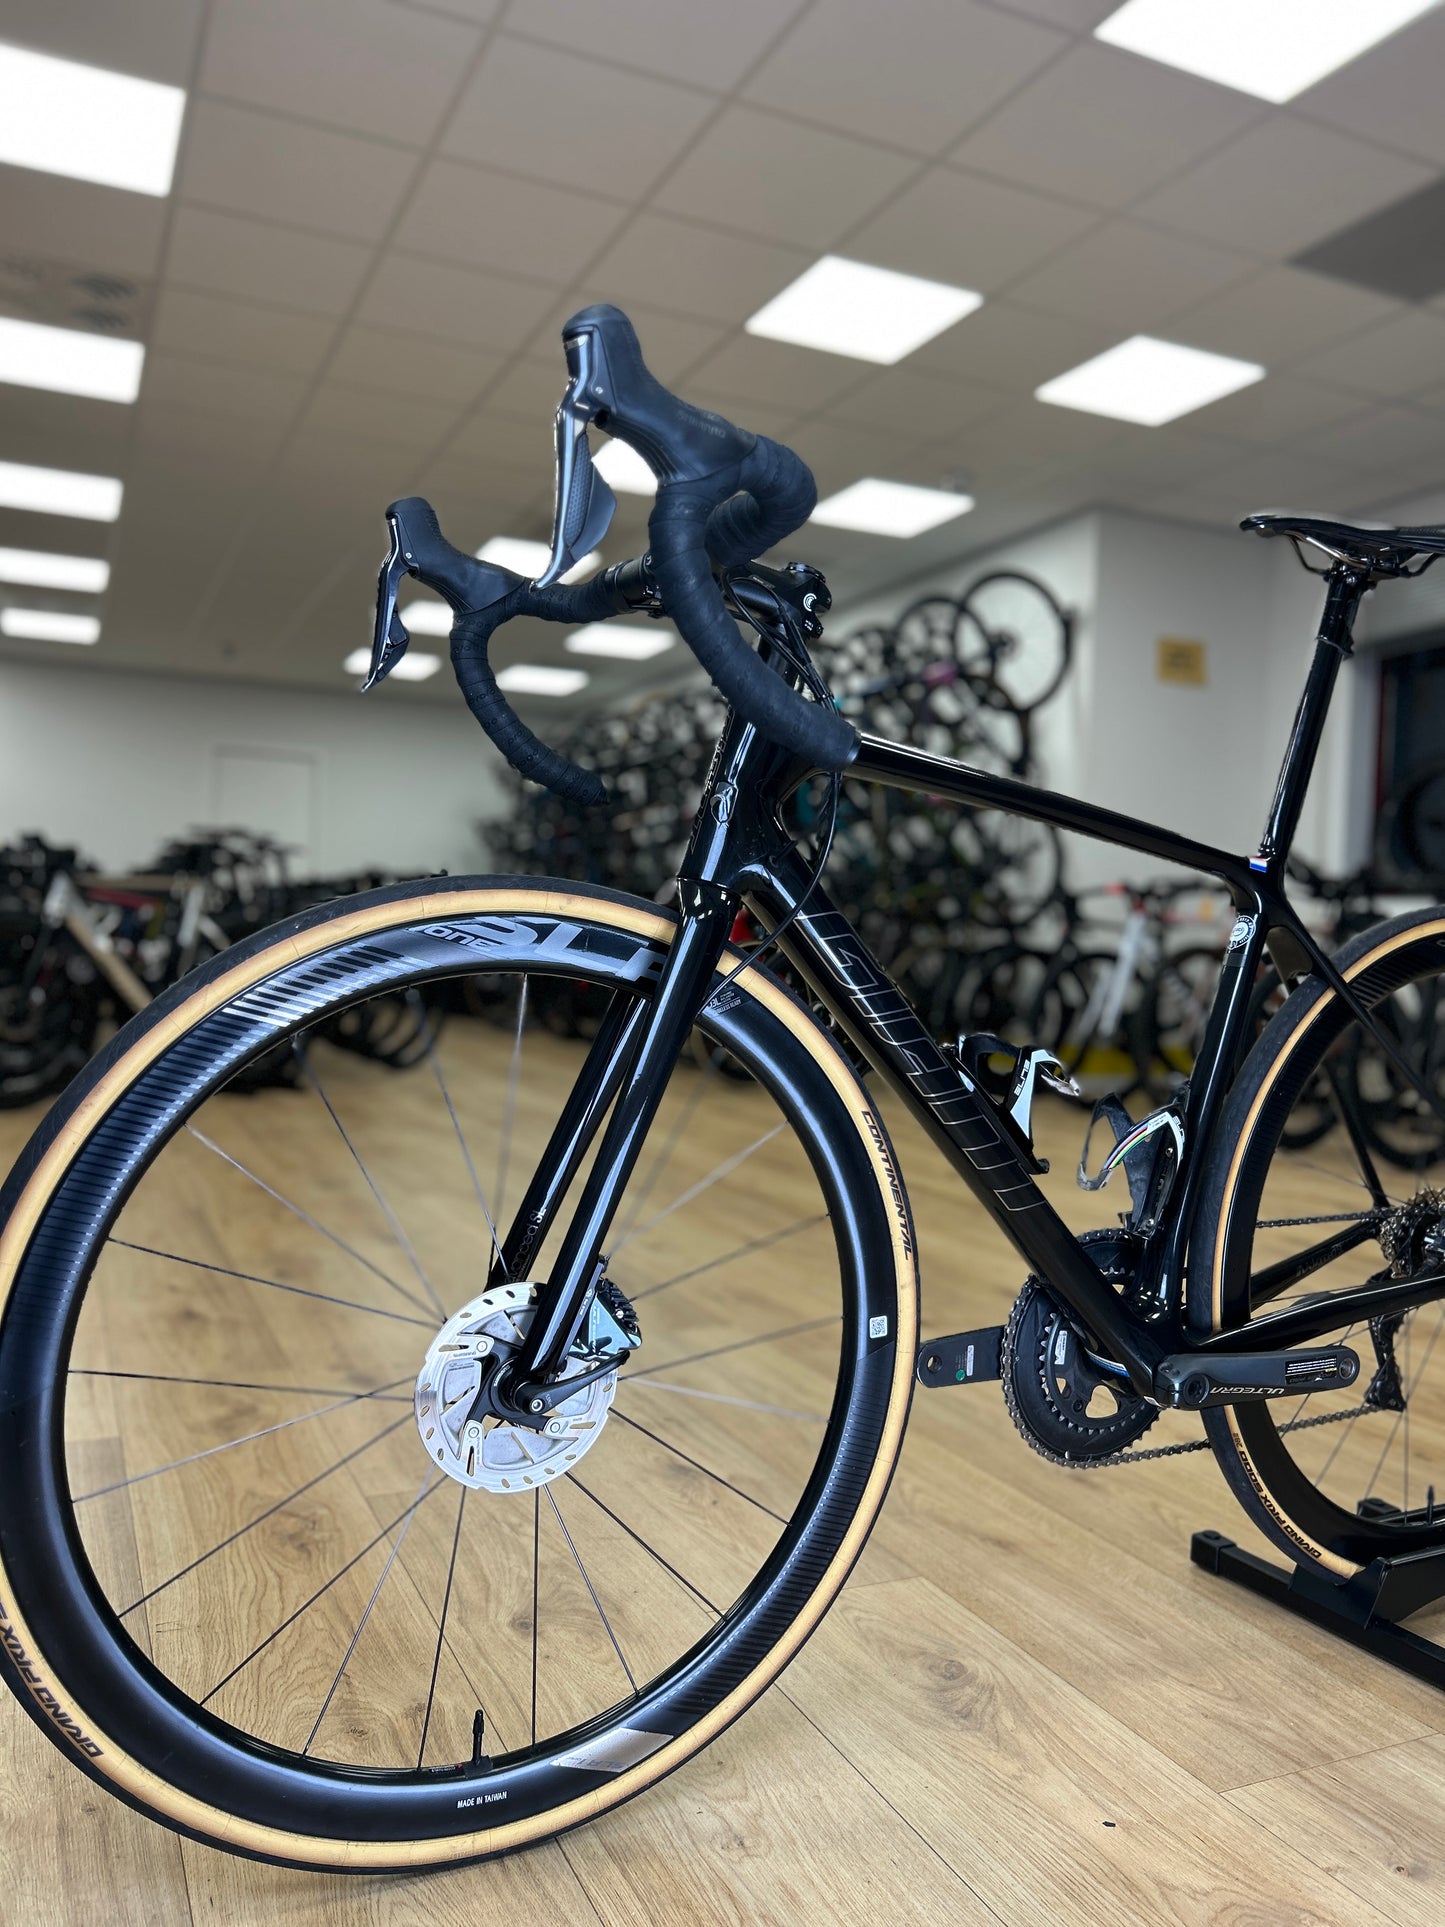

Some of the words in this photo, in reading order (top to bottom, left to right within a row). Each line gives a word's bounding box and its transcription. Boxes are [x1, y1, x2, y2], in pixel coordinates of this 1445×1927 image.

[793, 911, 1047, 1212] GIANT
[861, 1110, 912, 1261] CONTINENTAL
[529, 1207, 547, 1224] SL
[1210, 1386, 1286, 1395] ULTEGRA
[1239, 1450, 1264, 1494] 5000
[1260, 1493, 1286, 1526] PRIX
[1283, 1524, 1323, 1559] GRAND
[0, 1625, 42, 1684] PRIX
[33, 1687, 105, 1758] GRAND
[457, 1797, 475, 1809] MADE
[476, 1796, 483, 1805] IN
[484, 1791, 508, 1803] TAIWAN
